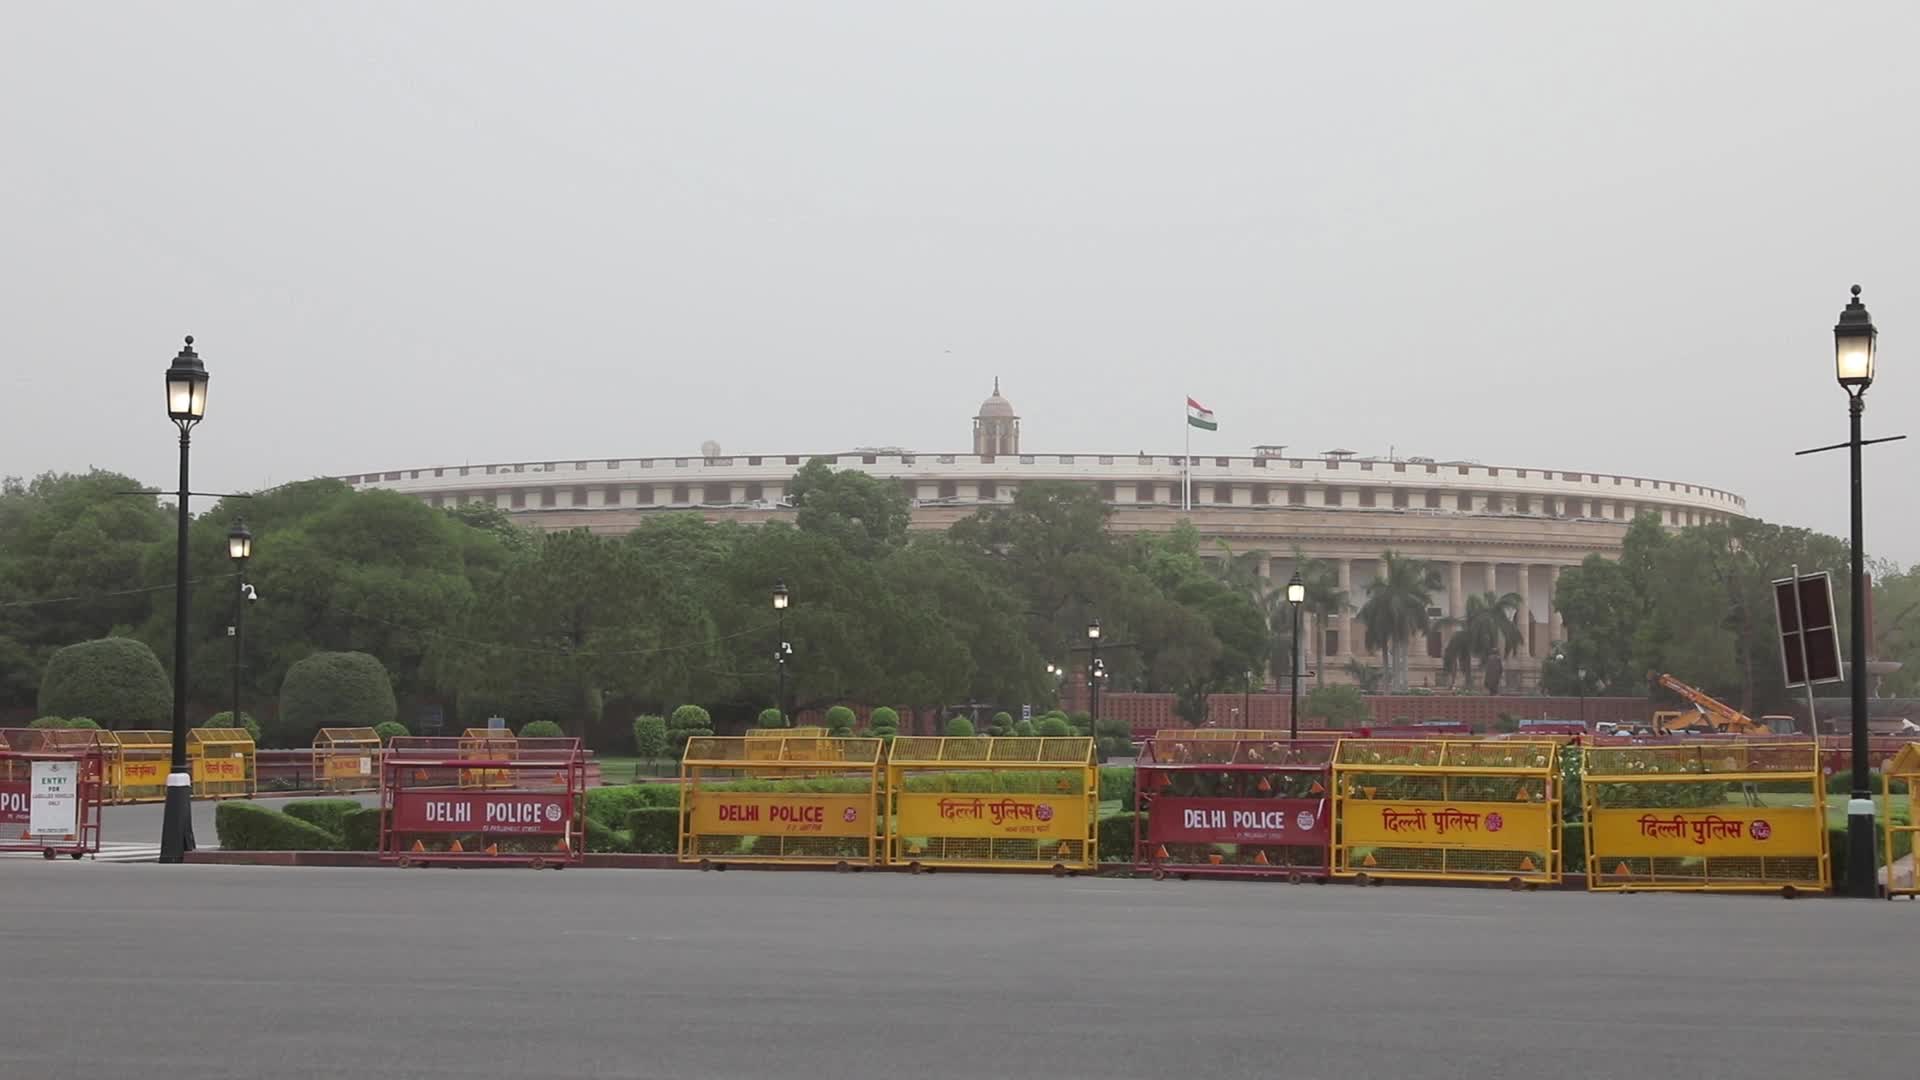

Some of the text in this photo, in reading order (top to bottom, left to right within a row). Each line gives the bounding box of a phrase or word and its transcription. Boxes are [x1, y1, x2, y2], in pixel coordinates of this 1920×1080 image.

[41, 777, 67, 785] ENTRY
[1, 793, 29, 811] POL
[937, 798, 1035, 826] दिल्ली पुलिस
[426, 802, 542, 823] DELHI POLICE
[719, 805, 824, 822] DELHI POLICE
[1184, 809, 1285, 829] DELHI POLICE
[1382, 808, 1480, 835] दिल्ली पुलिस
[1637, 814, 1744, 845] दिल्ली पुलिस
